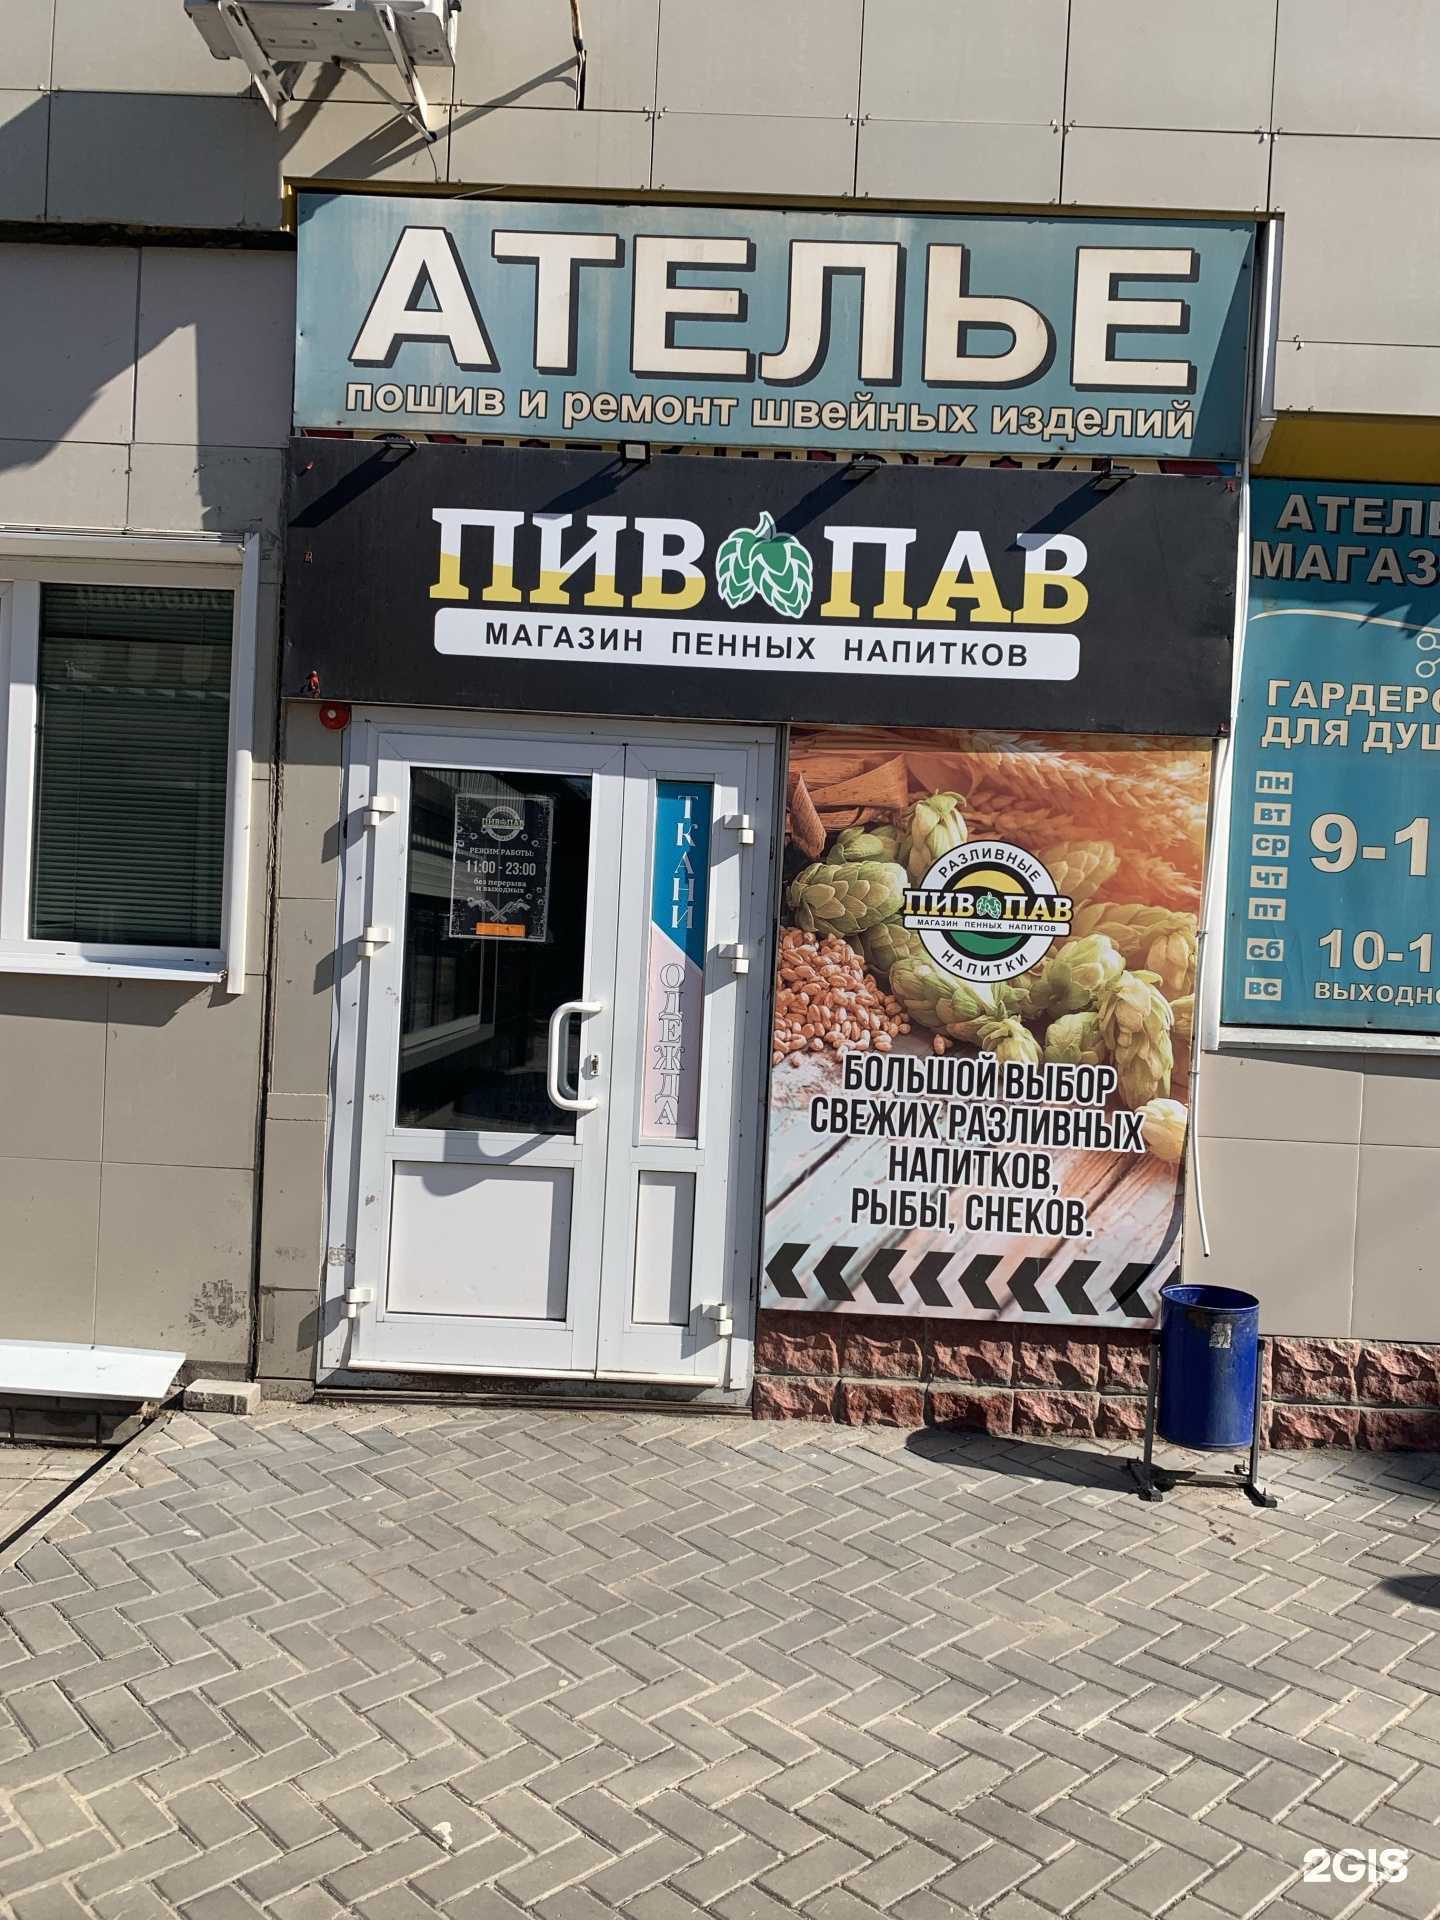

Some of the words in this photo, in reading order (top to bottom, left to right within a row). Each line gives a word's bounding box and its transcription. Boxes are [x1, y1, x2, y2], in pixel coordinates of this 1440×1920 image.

[348, 226, 1199, 393] АТЕЛЬЕ
[345, 382, 505, 416] пошив
[518, 389, 548, 418] и
[561, 387, 739, 429] ремонт
[751, 393, 977, 434] швейных
[991, 401, 1194, 443] изделий
[429, 508, 706, 610] ПИВ
[821, 526, 1089, 625] ПАВ
[1251, 541, 1438, 586] МАГАЗ
[484, 622, 644, 653] МАГАЗИН
[671, 631, 817, 660] ПЕННЫХ
[843, 638, 1028, 667] НАПИТКОВ
[1267, 679, 1440, 717] ГАРДЕР
[1260, 716, 1349, 750] ДЛЯ
[465, 860, 496, 874] 11:00
[505, 862, 537, 876] 23:00
[938, 848, 1041, 883] РАЗЛИВНЫЕ
[904, 890, 975, 917] ПИВ
[1003, 895, 1073, 921] ПАВ
[917, 919, 958, 928] МАГАЗИН
[964, 921, 1003, 929] ПЕННЫХ
[1008, 924, 1057, 932] НАПИТКОВ
[941, 949, 1028, 976] НАПИТКИ
[1314, 981, 1440, 1006] ВЫХОДН
[844, 1053, 997, 1098] БОЛЬШОЙ
[1005, 1064, 1116, 1103] ВЫБОР
[811, 1097, 940, 1139] СВЕЖИХ
[949, 1106, 1144, 1150] РАЗЛИВНЫХ
[888, 1146, 1059, 1195] НАПИТКОВ,
[851, 1188, 955, 1234] РЫБЫ,
[965, 1195, 1093, 1237] СНЕКОВ.
